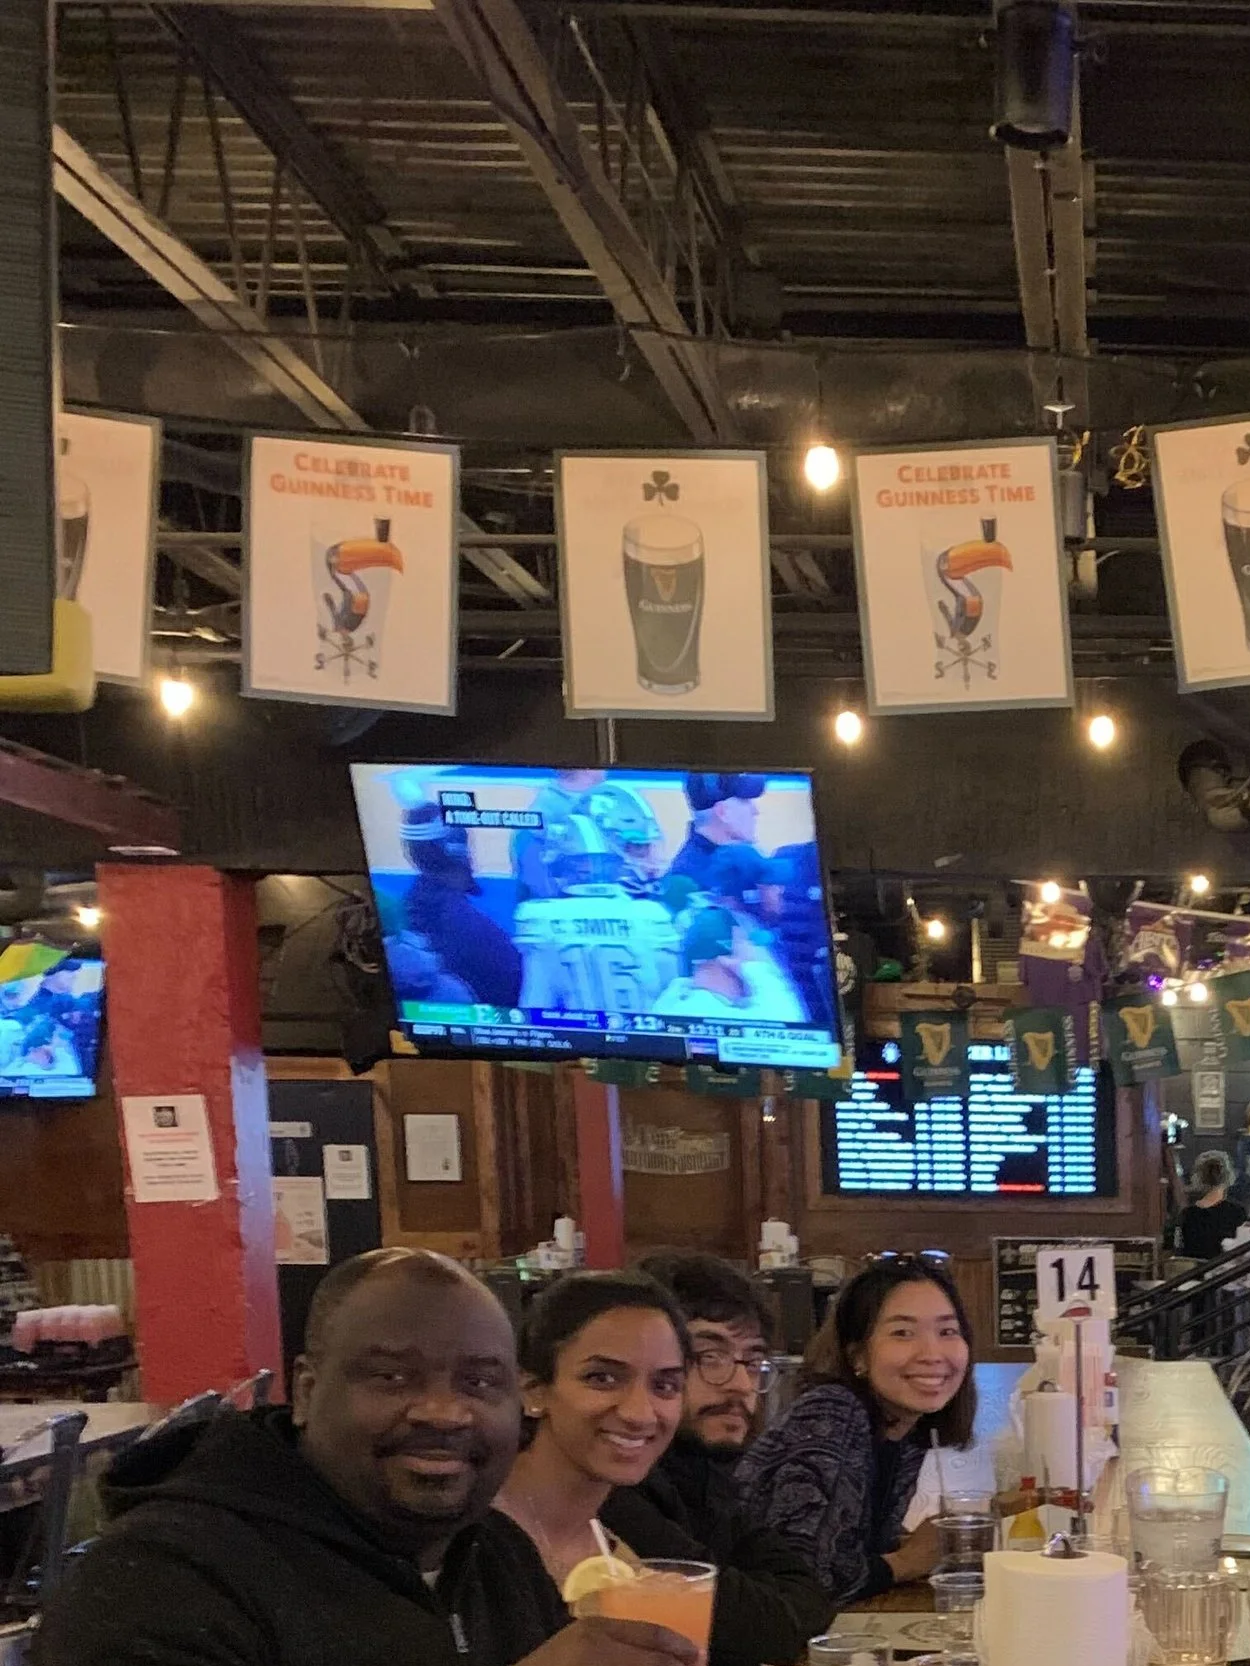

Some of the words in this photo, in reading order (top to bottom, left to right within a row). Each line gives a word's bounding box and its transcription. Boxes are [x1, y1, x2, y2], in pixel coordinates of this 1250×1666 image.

[293, 453, 410, 482] CELEBRATE
[897, 463, 1011, 483] CELEBRATE
[270, 473, 375, 501] GUINNESS
[383, 485, 434, 508] TIME
[876, 488, 980, 508] GUINNESS
[985, 485, 1036, 502] TIME
[573, 918, 631, 937] SMITH
[1050, 1256, 1100, 1301] 14
